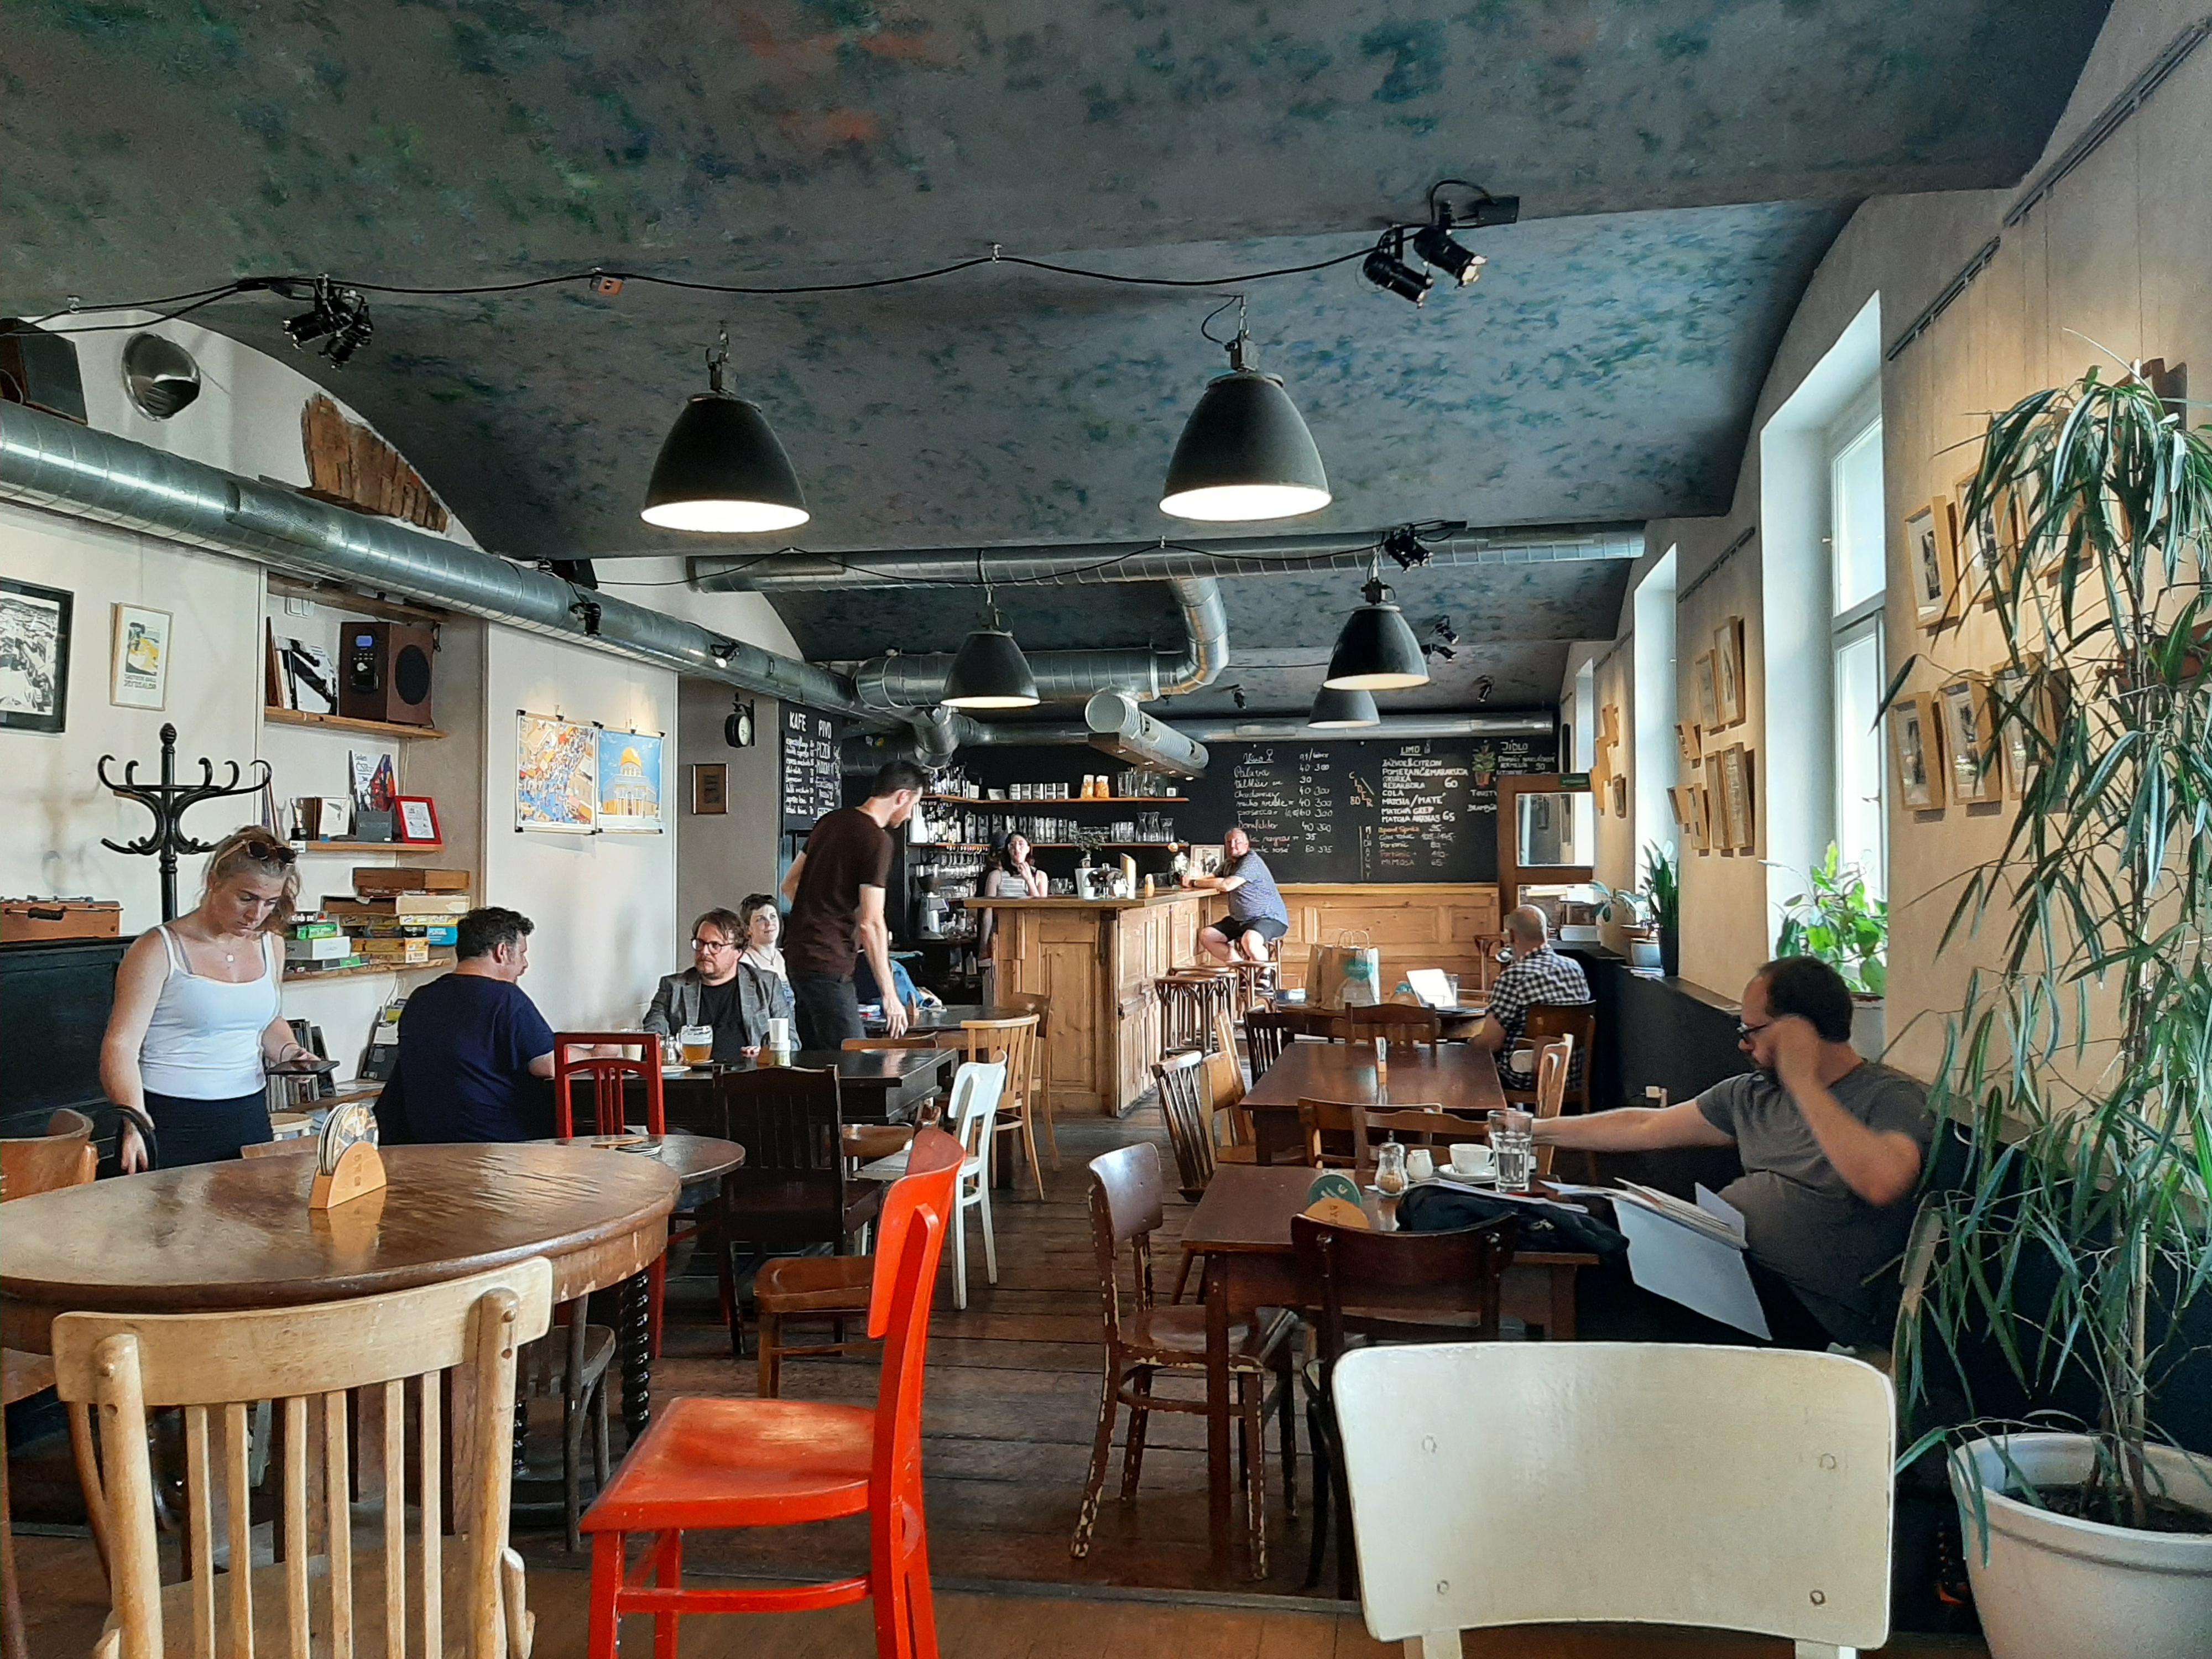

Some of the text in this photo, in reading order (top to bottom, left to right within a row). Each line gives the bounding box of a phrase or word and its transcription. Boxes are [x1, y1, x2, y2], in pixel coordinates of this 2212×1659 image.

[789, 711, 806, 732] KAFE
[818, 719, 832, 739] PIVO
[1401, 745, 1421, 754] LIMO
[1500, 739, 1528, 751] JÍDLO
[1444, 776, 1458, 788] 60
[1349, 771, 1374, 807] CIDER
[1300, 798, 1332, 807] 40 300
[1314, 808, 1333, 818] 300
[1442, 810, 1455, 822] 65
[1301, 821, 1314, 832] 40
